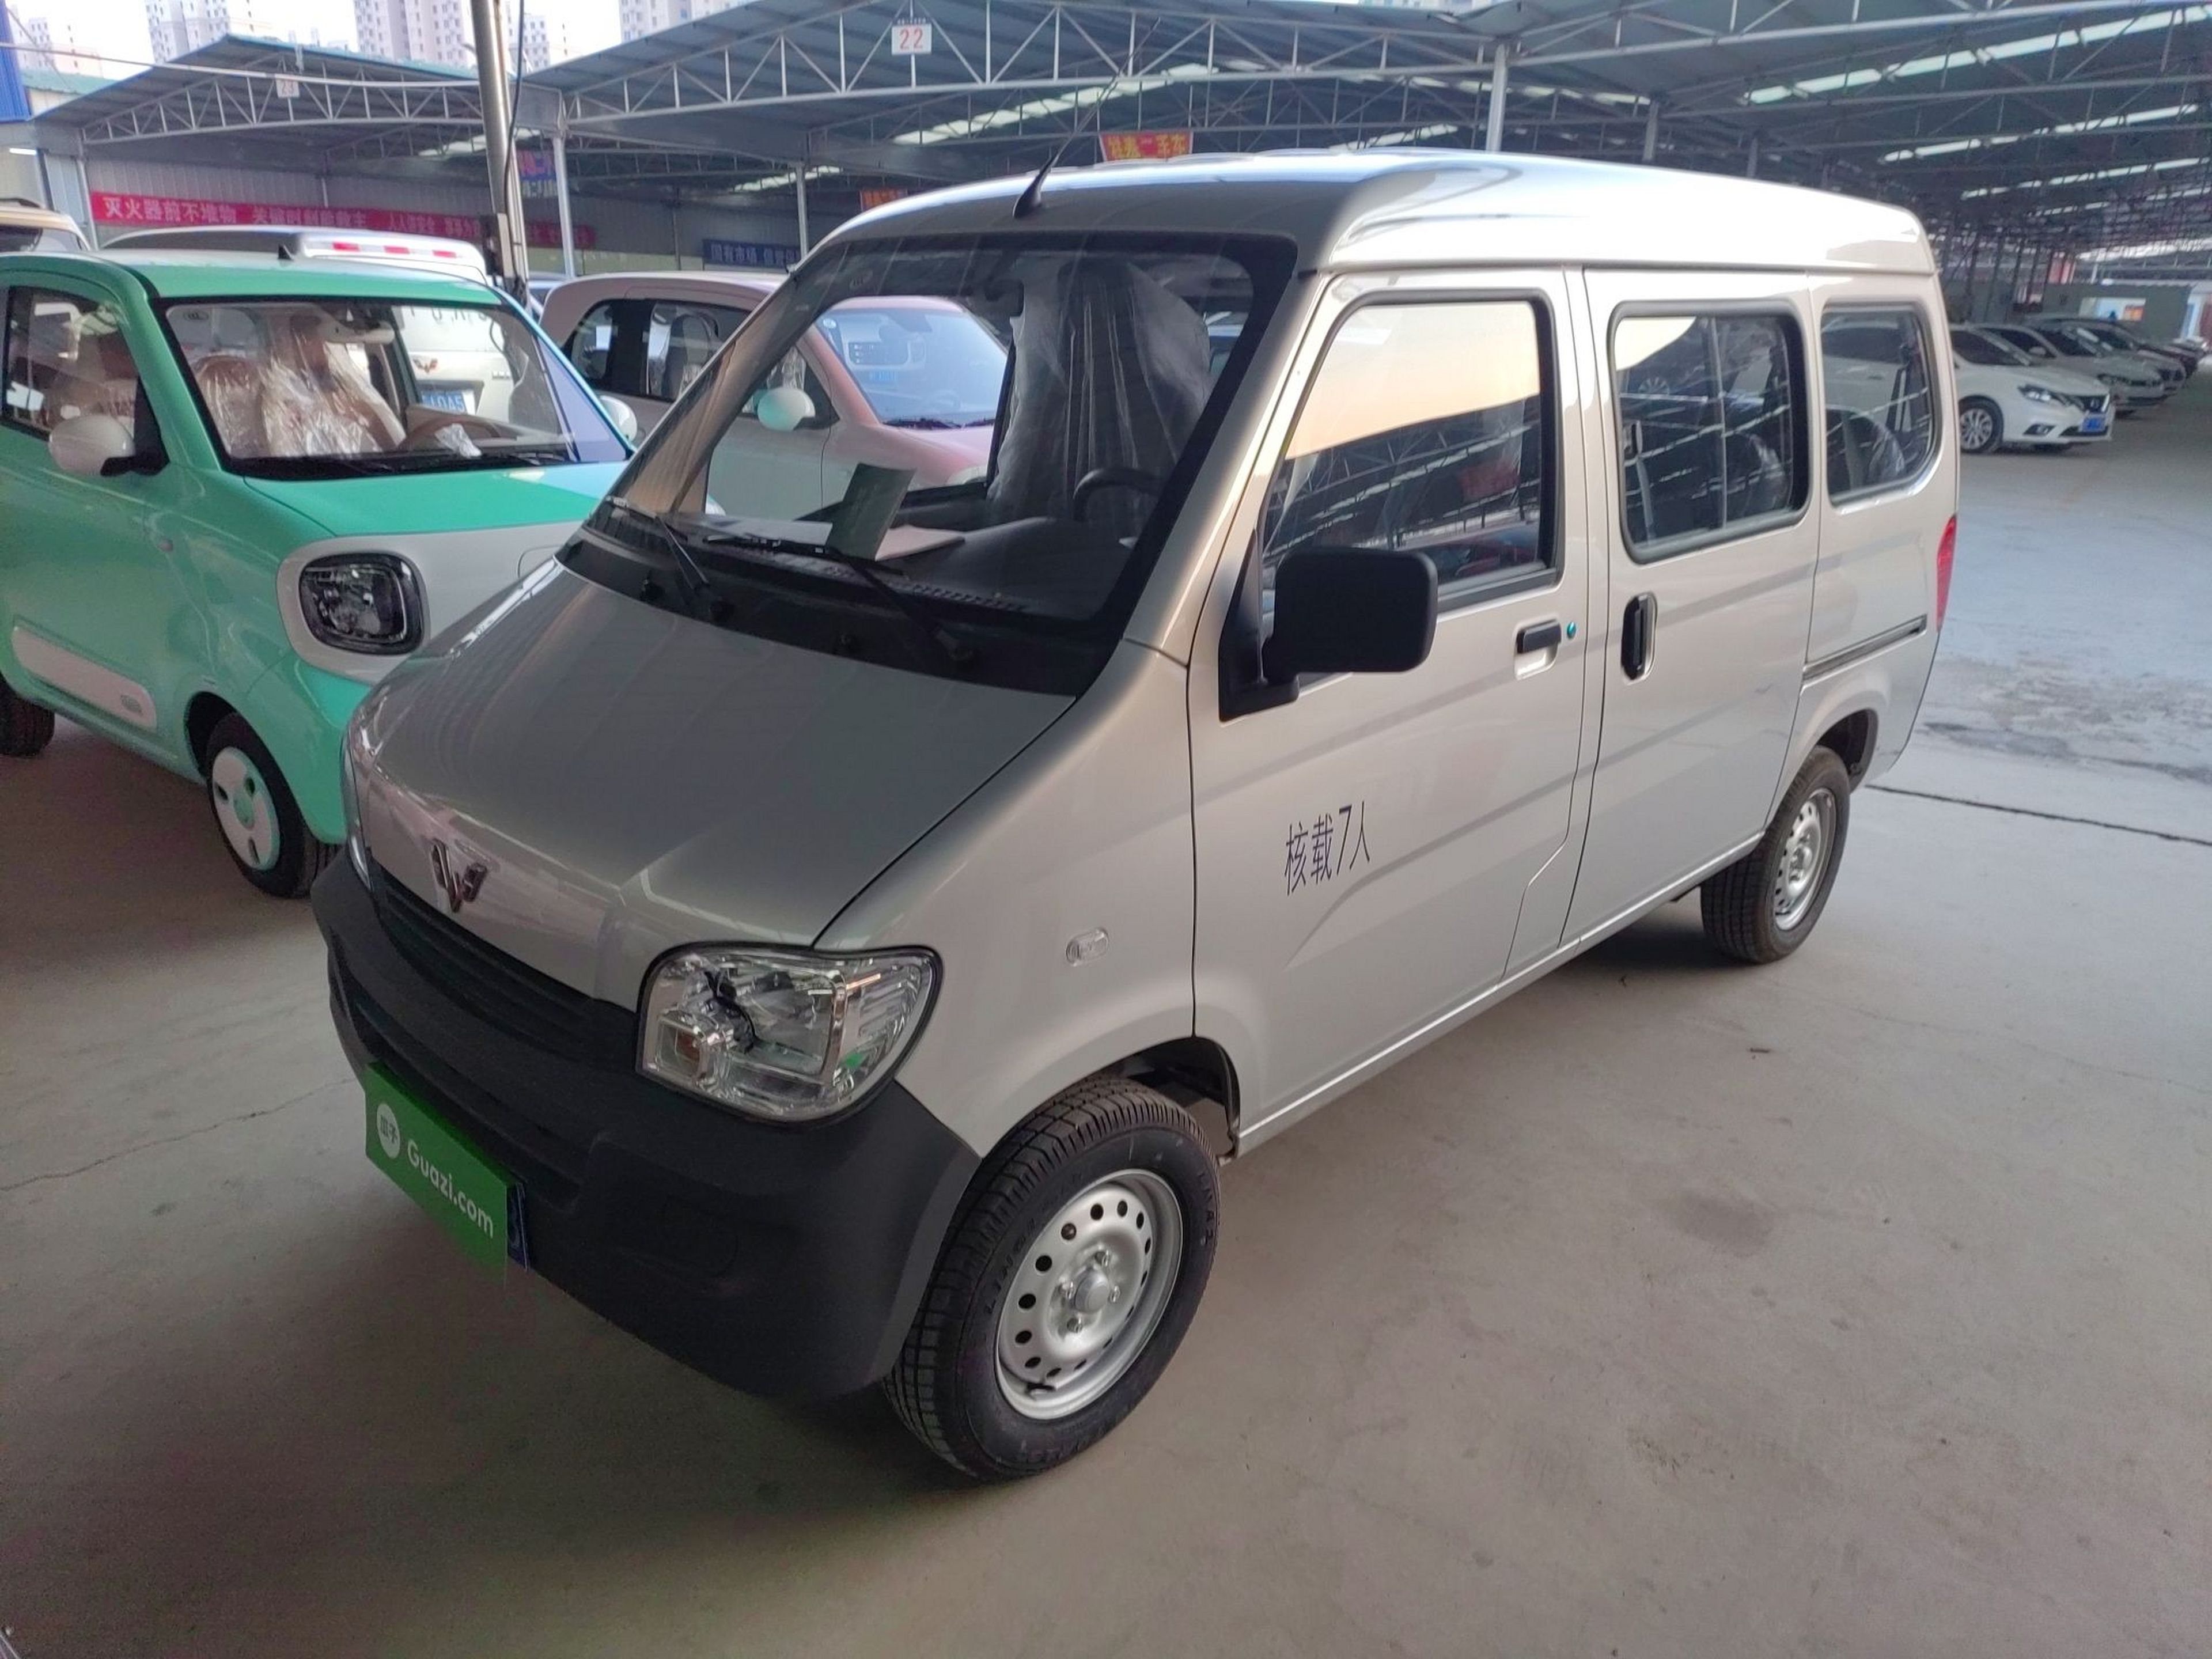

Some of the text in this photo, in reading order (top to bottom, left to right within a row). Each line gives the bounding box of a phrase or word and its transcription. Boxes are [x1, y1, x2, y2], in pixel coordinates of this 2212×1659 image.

[900, 28, 923, 50] 22
[102, 196, 237, 224] 灭火器前不堆物
[1284, 800, 1370, 896] 核载7人
[407, 1139, 494, 1239] Guazi.com
